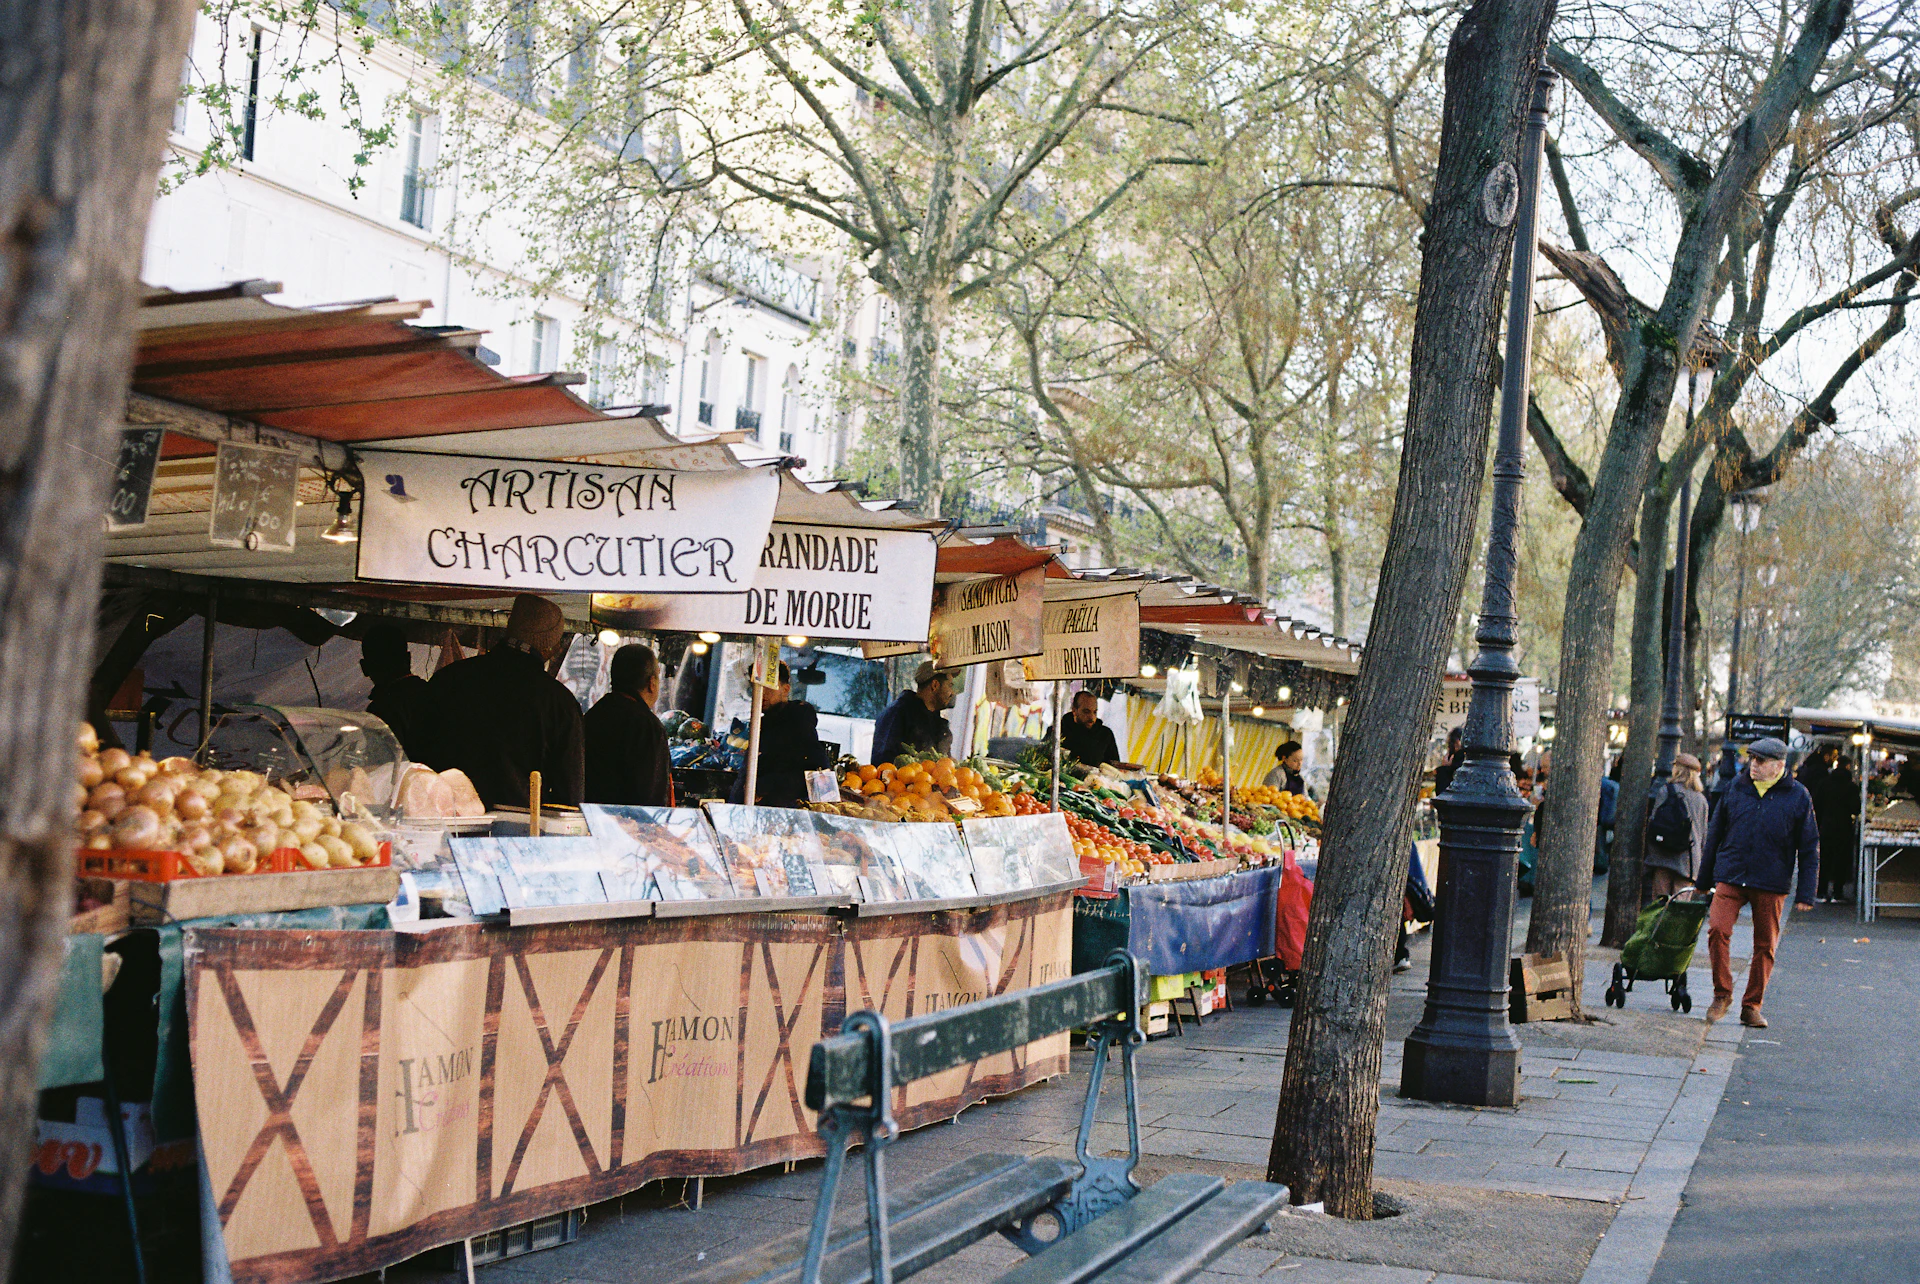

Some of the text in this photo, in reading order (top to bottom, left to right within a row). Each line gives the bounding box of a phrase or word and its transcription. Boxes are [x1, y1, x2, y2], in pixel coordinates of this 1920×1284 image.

[461, 468, 677, 518] ARTISAN
[428, 526, 738, 583] CHARCUTIER
[759, 532, 879, 574] RANDADE
[744, 587, 872, 630] DE MORUE
[961, 576, 1019, 611] SANDWICHS
[972, 619, 1011, 655] MAISON
[1063, 646, 1102, 675] ROYALE
